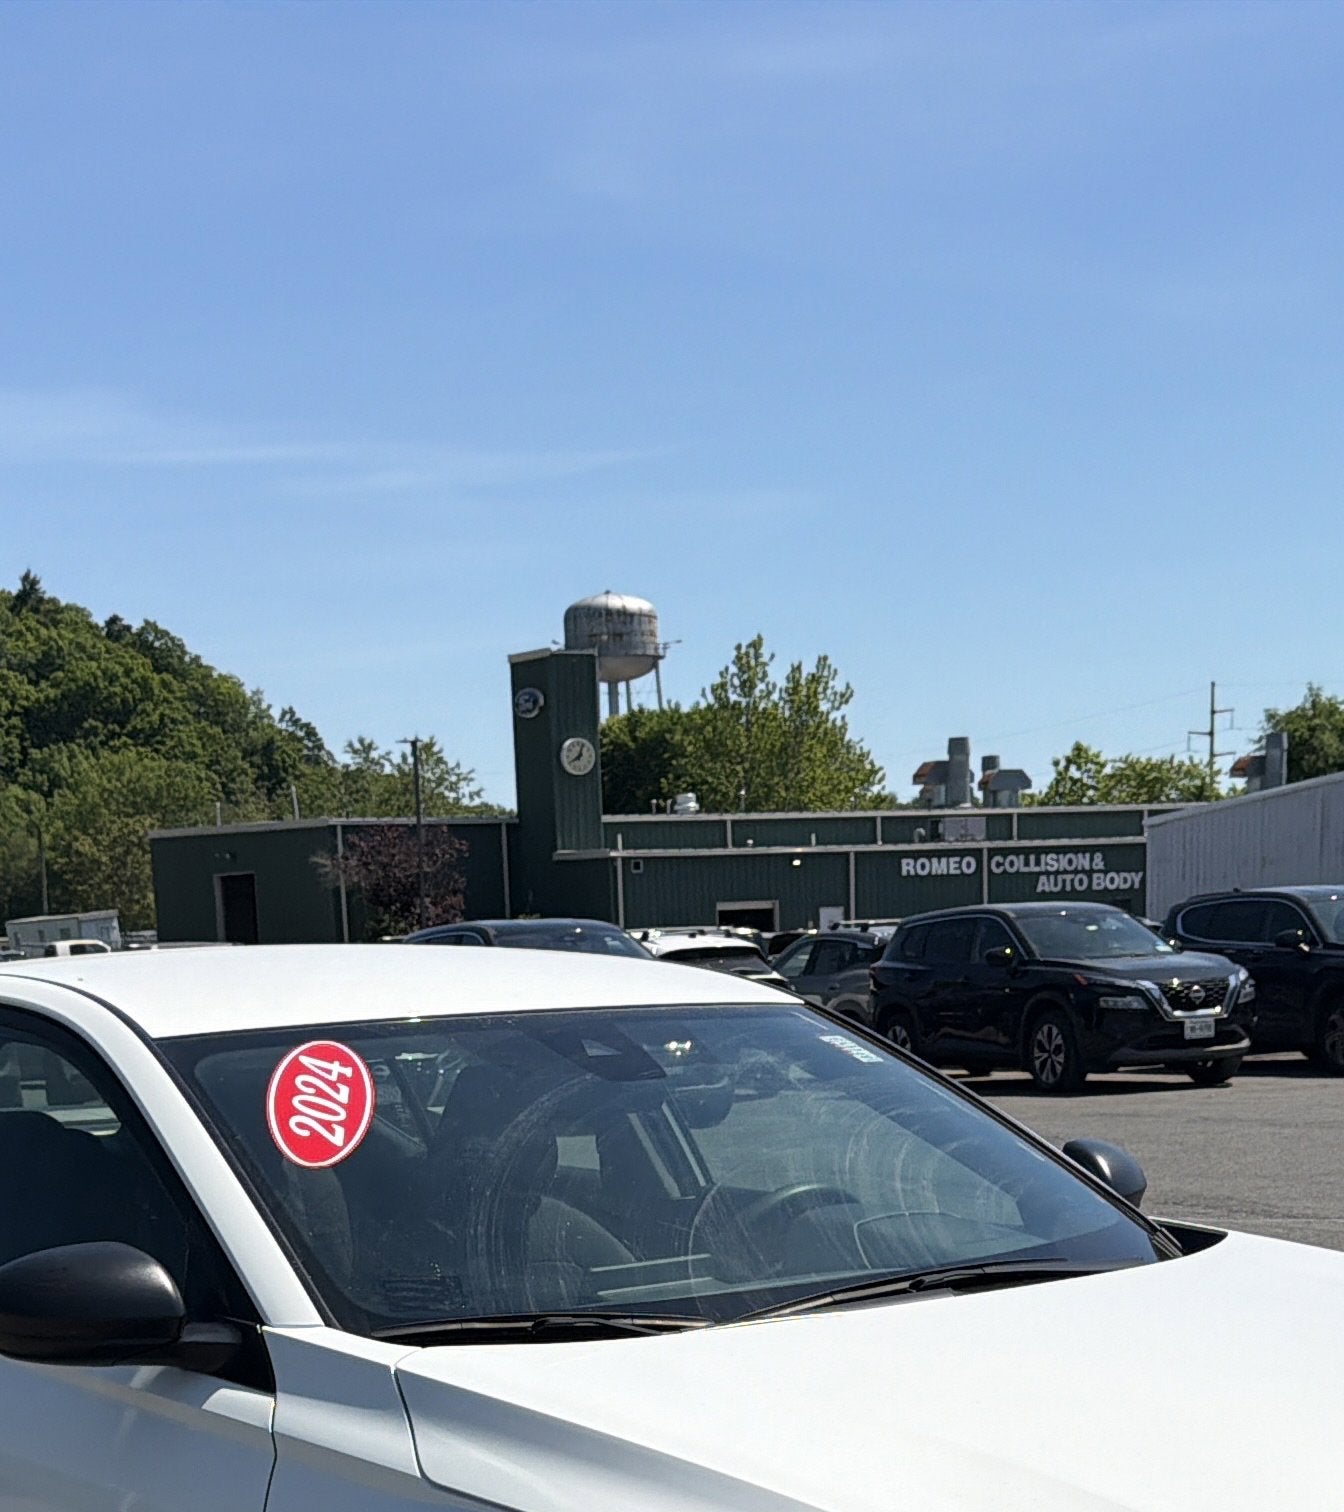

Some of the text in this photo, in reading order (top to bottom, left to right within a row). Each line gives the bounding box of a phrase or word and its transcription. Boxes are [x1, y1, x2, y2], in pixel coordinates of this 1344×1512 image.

[901, 856, 976, 876] ROMEO
[990, 853, 1091, 874] COLLISION
[1036, 871, 1144, 893] AUTO BODY
[289, 1055, 353, 1147] 2024
